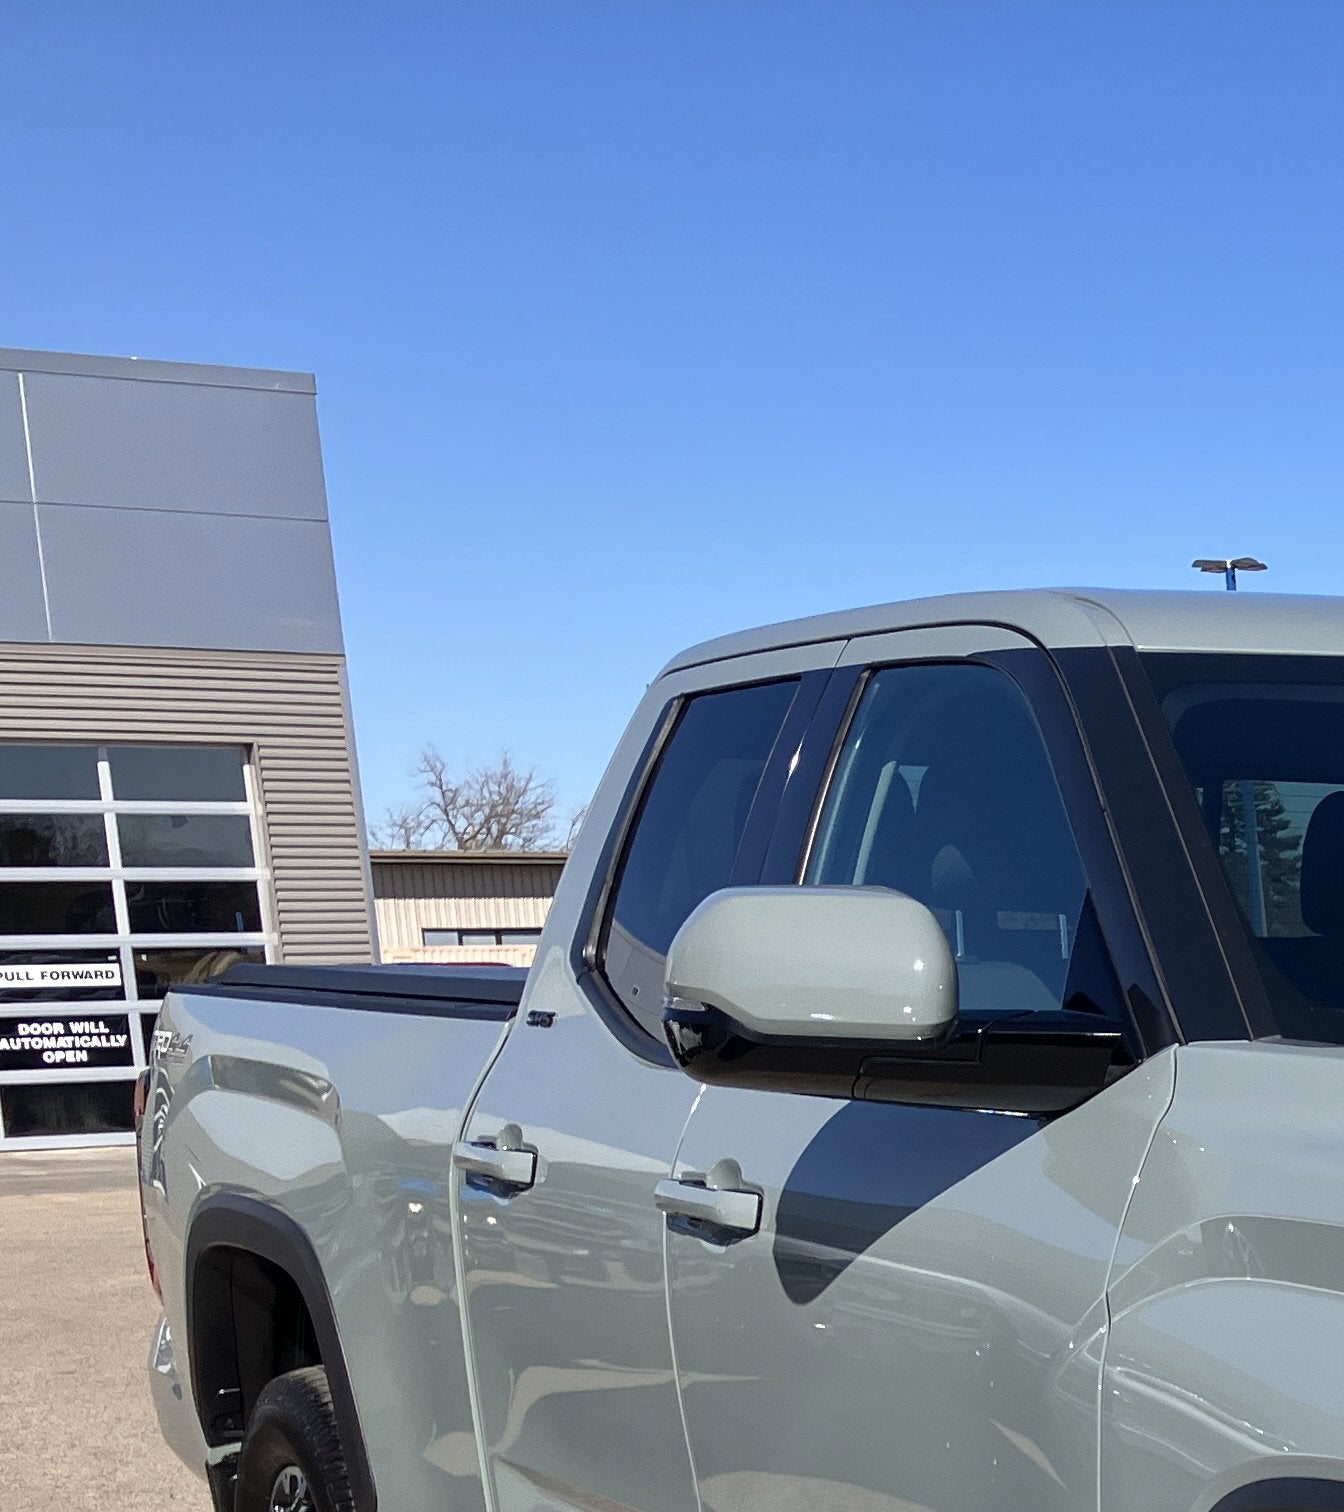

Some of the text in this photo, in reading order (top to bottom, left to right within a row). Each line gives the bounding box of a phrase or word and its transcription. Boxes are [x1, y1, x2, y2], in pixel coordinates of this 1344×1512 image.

[40, 970, 115, 980] FORWARD
[17, 1021, 110, 1036] DOOR WILL
[0, 1034, 128, 1051] AUTOMATICALLY
[42, 1050, 88, 1064] OPEN
